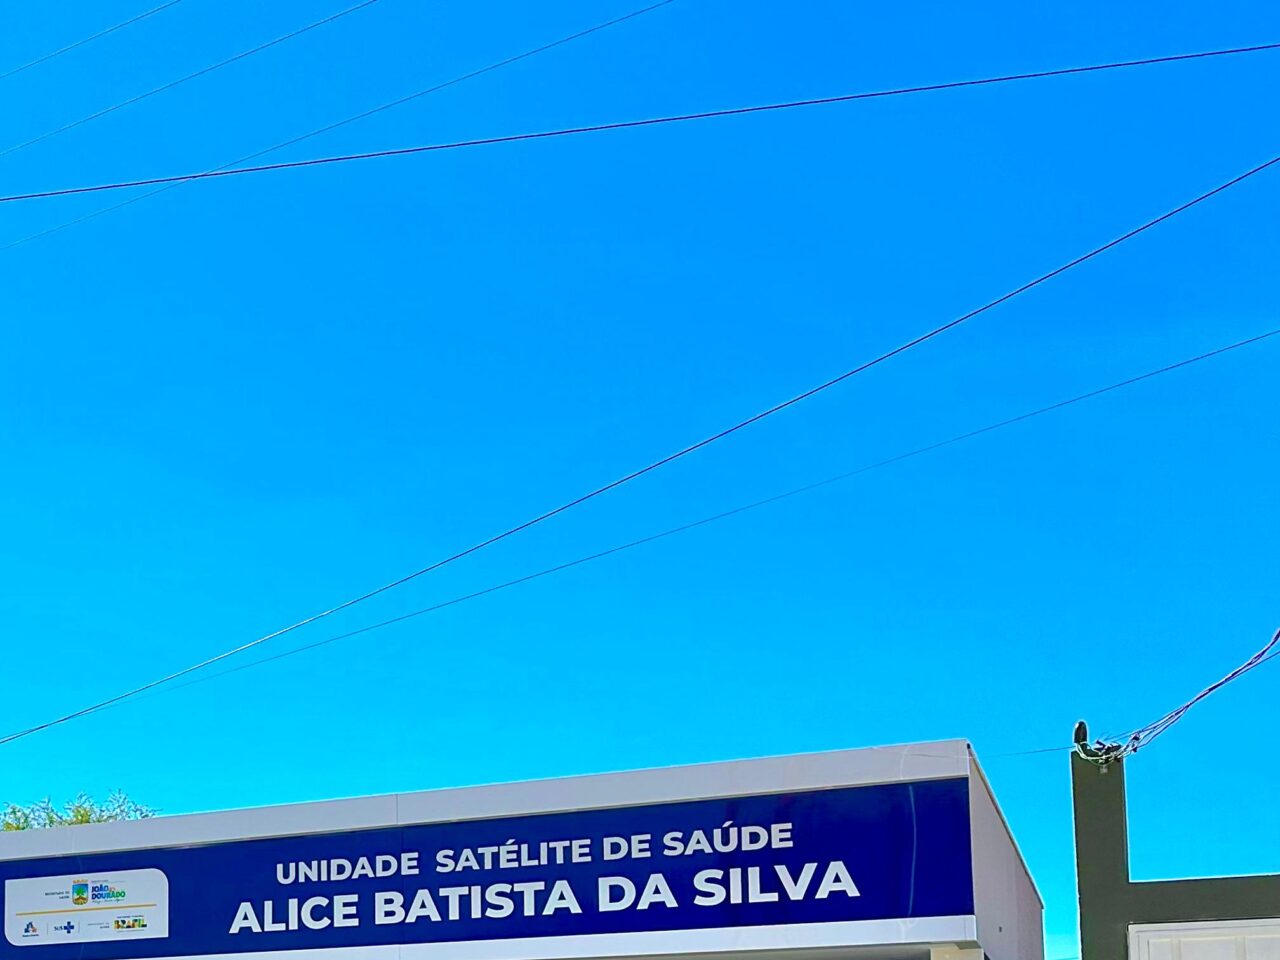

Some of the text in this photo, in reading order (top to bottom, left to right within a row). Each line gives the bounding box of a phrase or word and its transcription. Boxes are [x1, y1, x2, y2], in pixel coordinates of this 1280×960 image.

[276, 820, 793, 885] UNIDADE SATÉLITE DE SAÚDE
[91, 884, 109, 893] JOÃO
[91, 890, 125, 900] DOURADO
[228, 860, 860, 934] ALICE BATISTA DA SILVA
